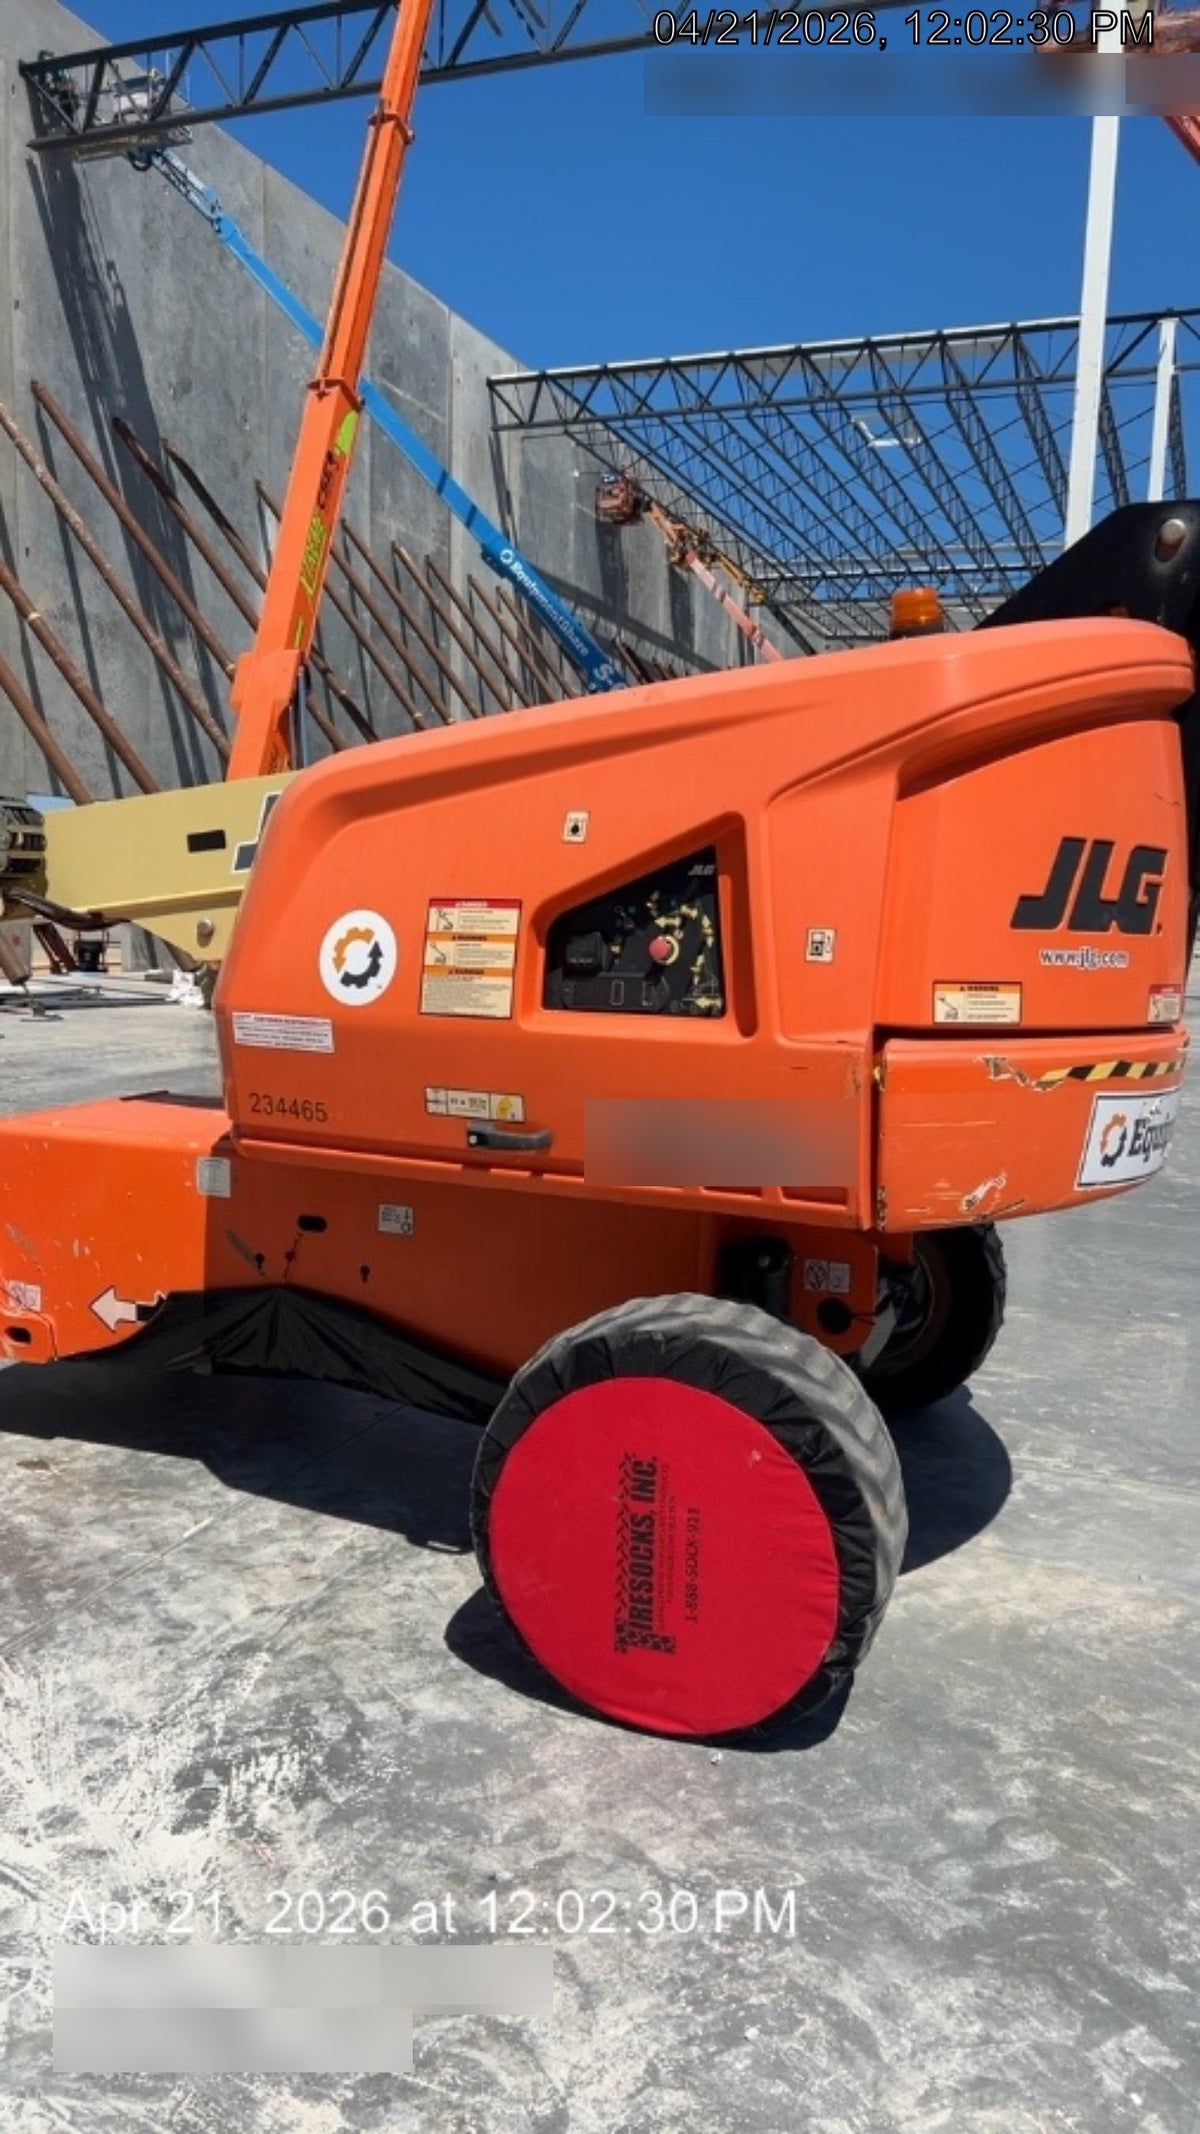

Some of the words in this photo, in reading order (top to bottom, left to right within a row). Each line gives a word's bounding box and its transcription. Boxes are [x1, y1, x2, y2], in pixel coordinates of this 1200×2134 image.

[510, 561, 590, 657] EquipmentShare
[1009, 836, 1169, 935] JLG
[1039, 946, 1129, 969] www.jlg.com
[248, 1092, 329, 1122] 234465
[628, 1456, 659, 1504] INC.
